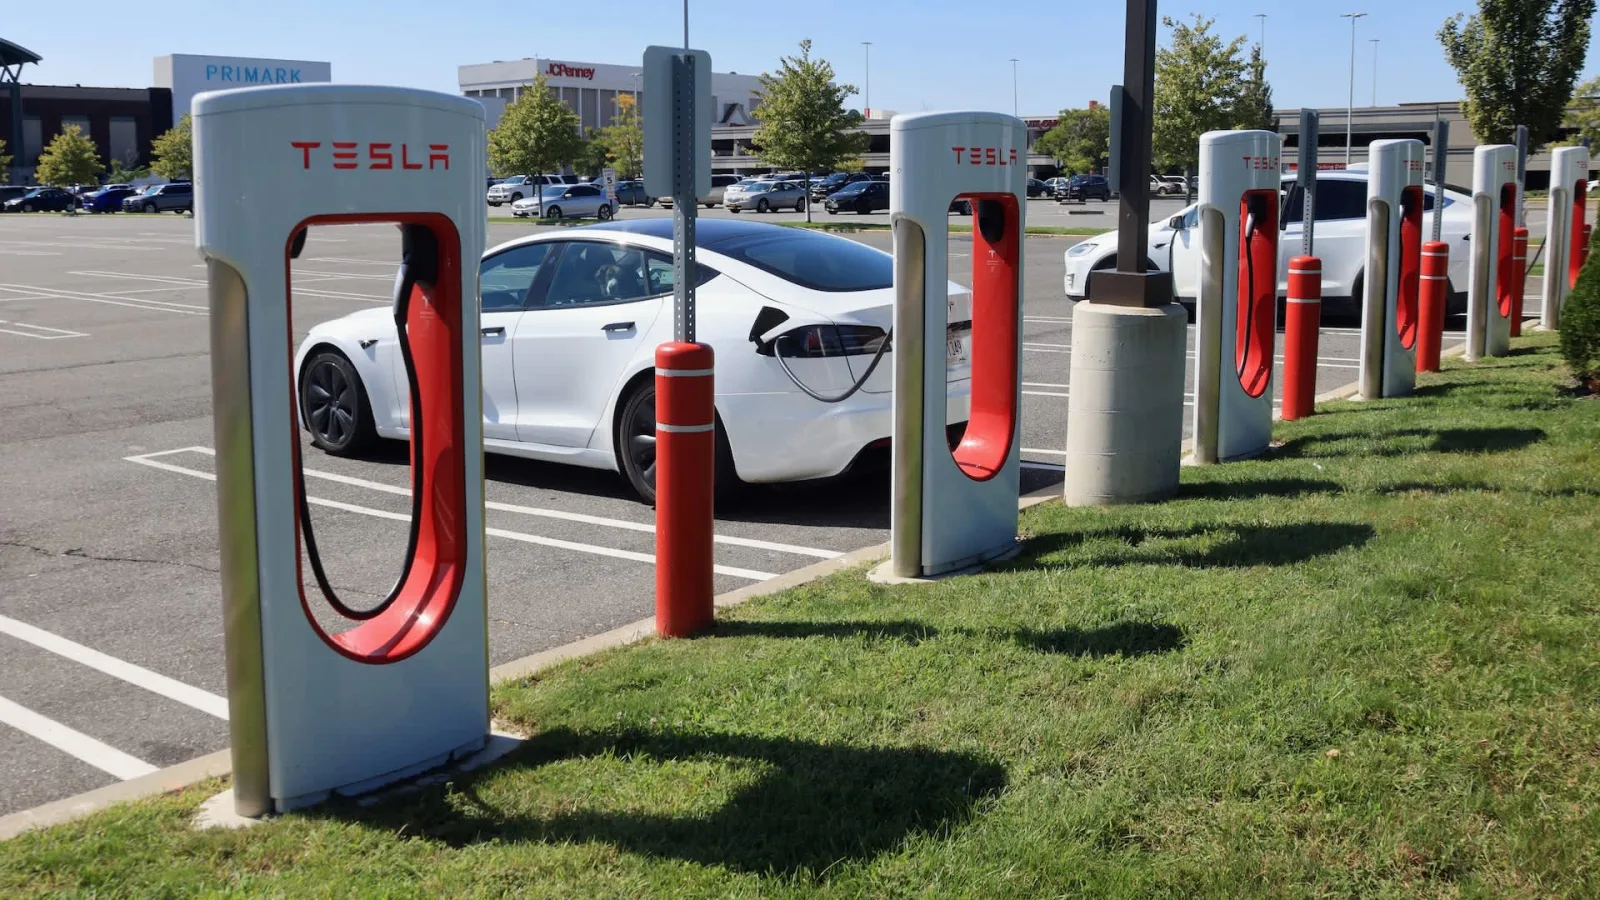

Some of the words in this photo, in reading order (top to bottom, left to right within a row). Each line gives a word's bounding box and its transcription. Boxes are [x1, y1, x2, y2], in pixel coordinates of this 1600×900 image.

[206, 64, 302, 83] PRIMARK
[545, 63, 595, 80] JCPenney
[292, 142, 449, 170] TESLA
[951, 147, 1018, 166] TESLA
[606, 176, 613, 184] 5
